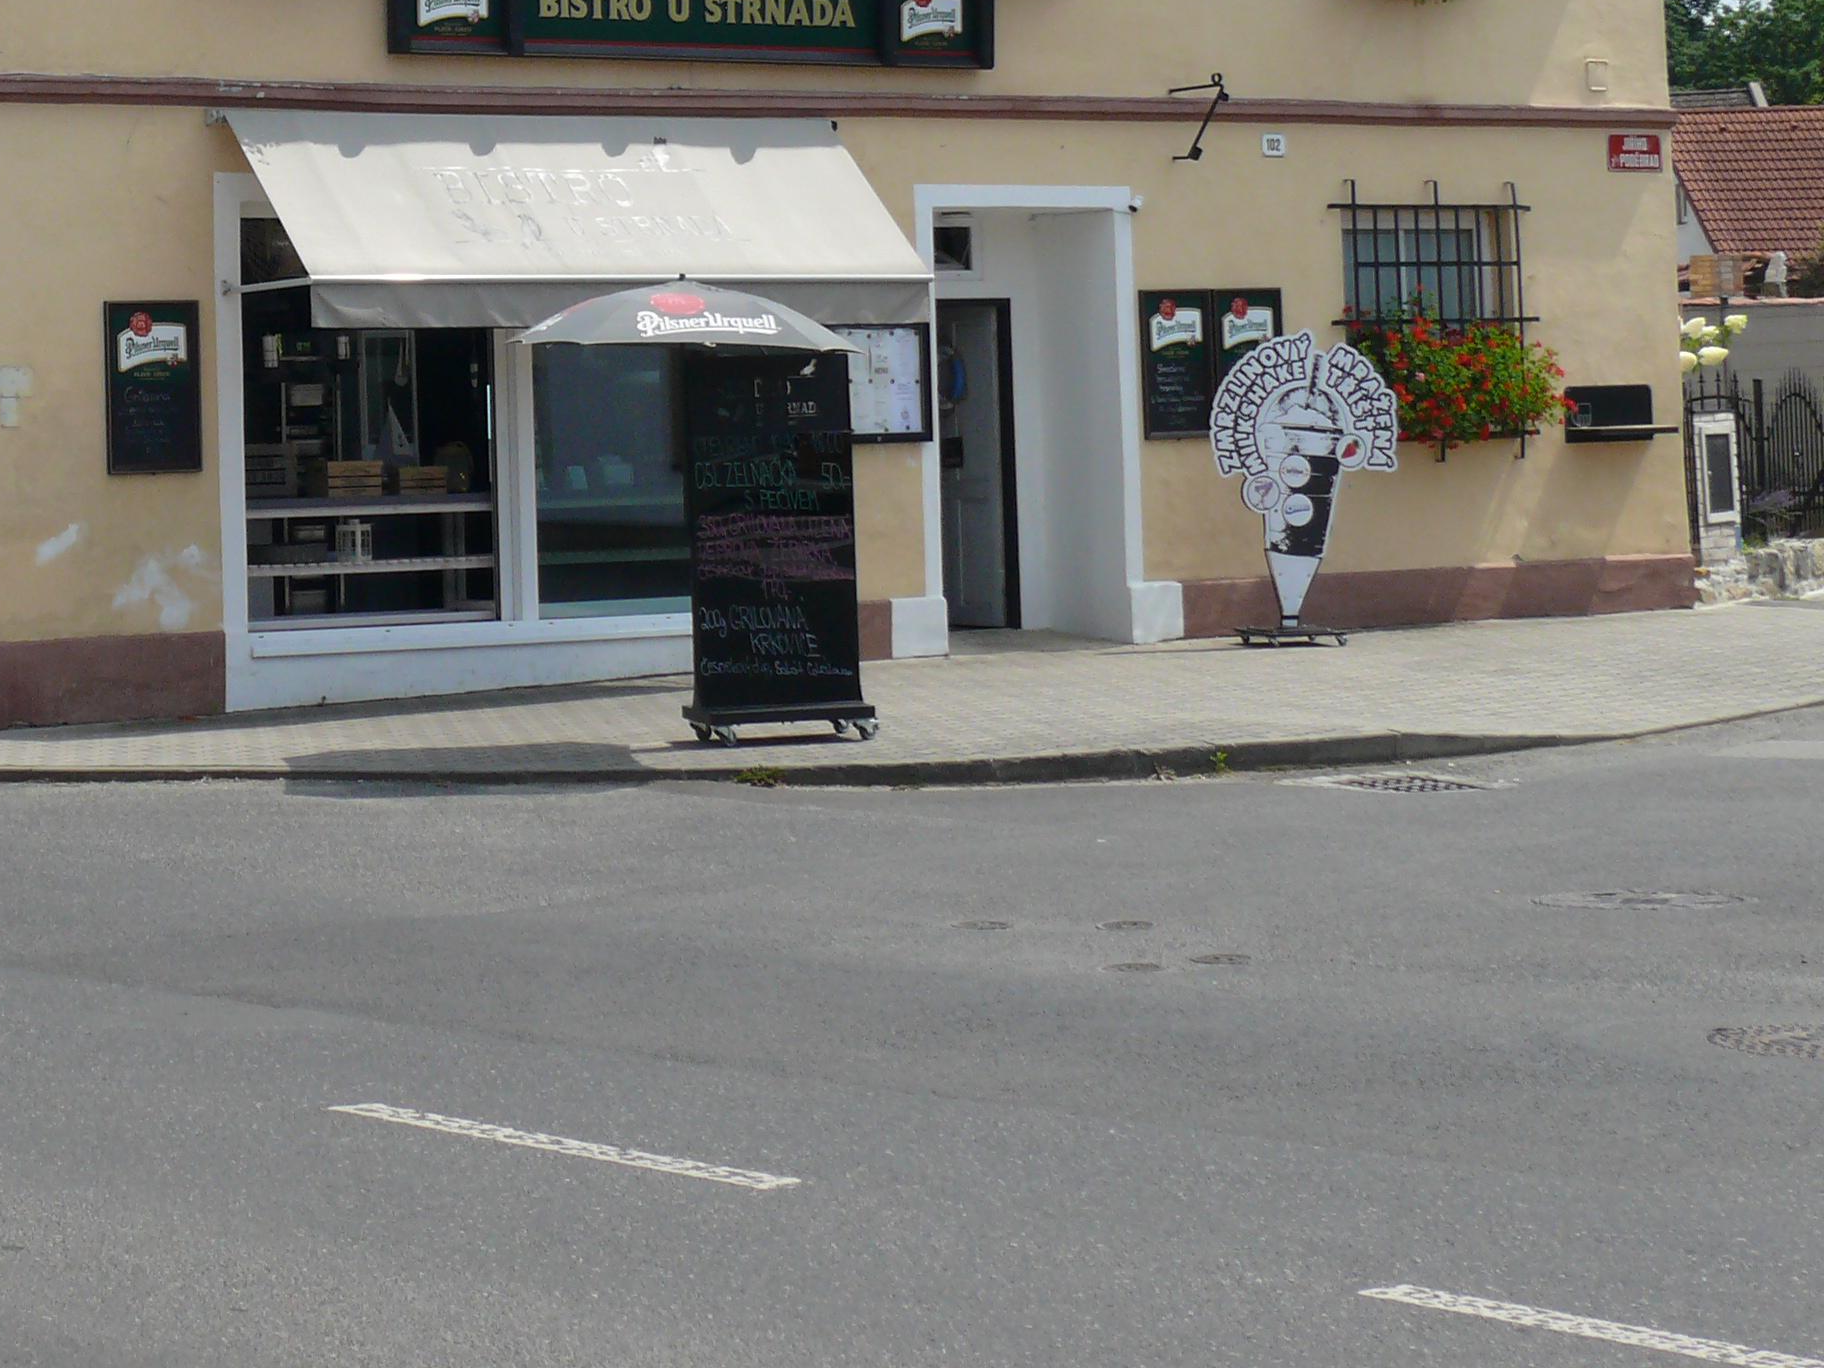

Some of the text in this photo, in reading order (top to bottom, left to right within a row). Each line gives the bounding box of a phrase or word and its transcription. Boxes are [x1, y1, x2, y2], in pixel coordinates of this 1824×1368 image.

[1266, 138, 1281, 152] 102
[637, 311, 777, 337] Pilsner Urquell
[1214, 332, 1311, 475] ZMRZLINOVÝ
[1234, 361, 1307, 476] MILKSHAKE
